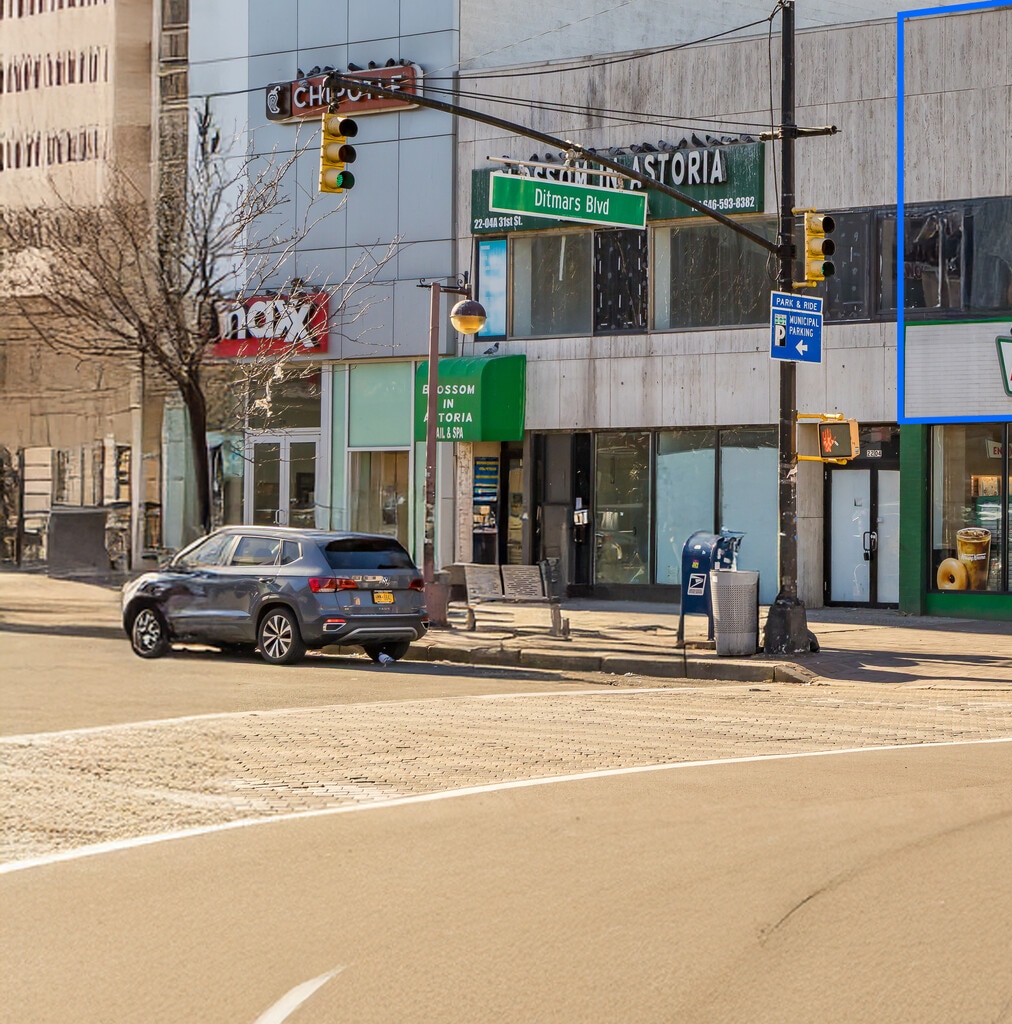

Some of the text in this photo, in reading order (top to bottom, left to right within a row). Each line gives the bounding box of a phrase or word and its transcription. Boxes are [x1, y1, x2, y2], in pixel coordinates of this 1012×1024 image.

[630, 149, 723, 190] ASTORIA
[534, 188, 609, 215] Ditmars Blvd
[703, 196, 755, 211] 646-593-8382
[474, 216, 523, 229] 22-04A 31st St.
[776, 297, 818, 311] PARK & RIDE
[789, 315, 819, 327] MUNICIPAL
[789, 326, 814, 337] PARKING
[422, 384, 475, 394] BOSSOM
[443, 399, 454, 409] IN
[423, 412, 472, 422] ATORIA
[436, 426, 464, 438] AIL & SPA
